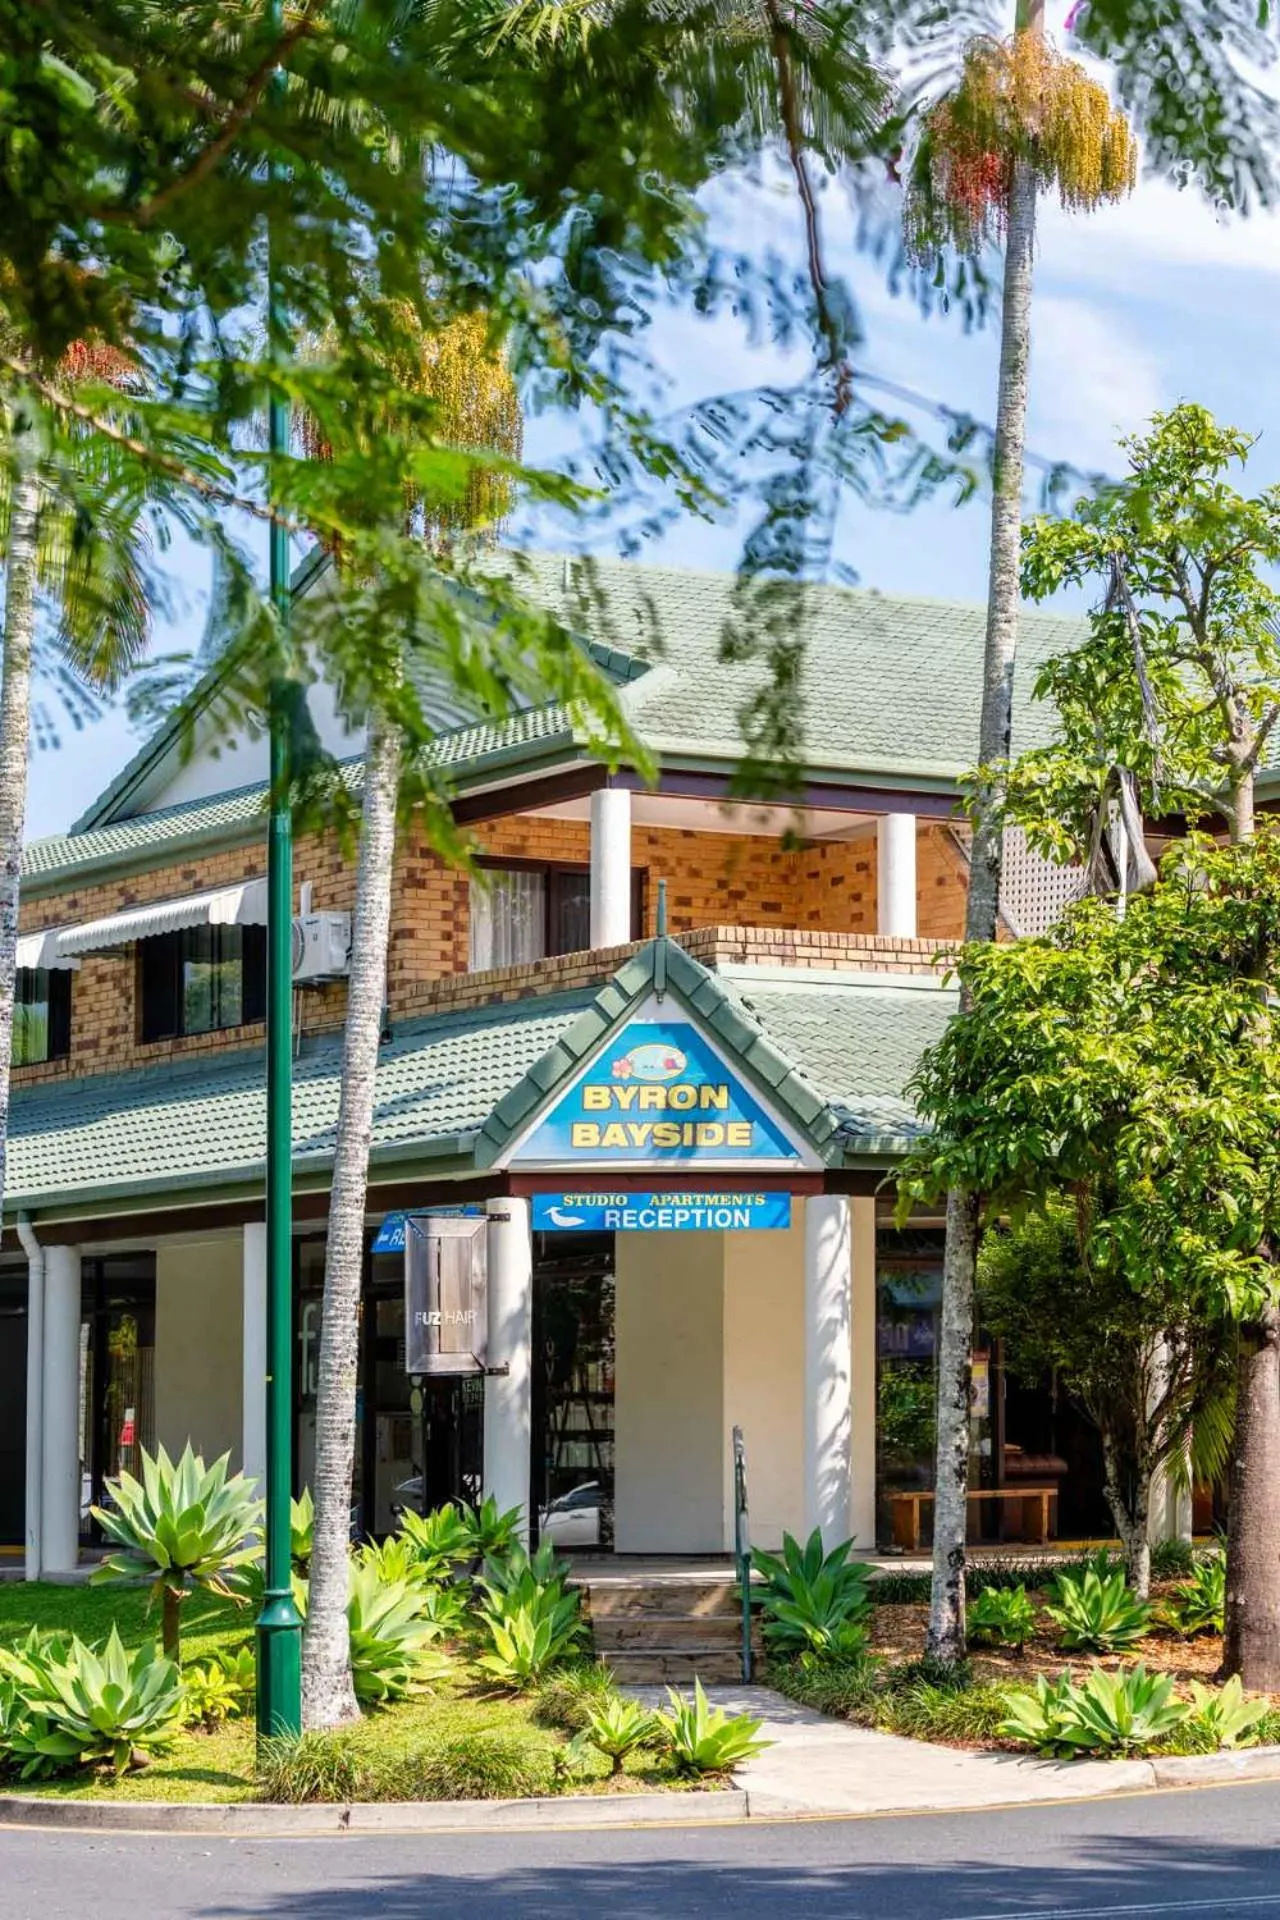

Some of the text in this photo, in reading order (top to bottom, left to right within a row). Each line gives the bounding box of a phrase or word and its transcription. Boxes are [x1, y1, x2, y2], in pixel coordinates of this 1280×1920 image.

[582, 1084, 729, 1110] BYRON
[571, 1122, 752, 1148] BAYSIDE
[563, 1194, 766, 1207] STUDIO APARTMENTS
[604, 1208, 751, 1228] RECEPTION
[415, 1310, 477, 1326] FUZ HAIR
